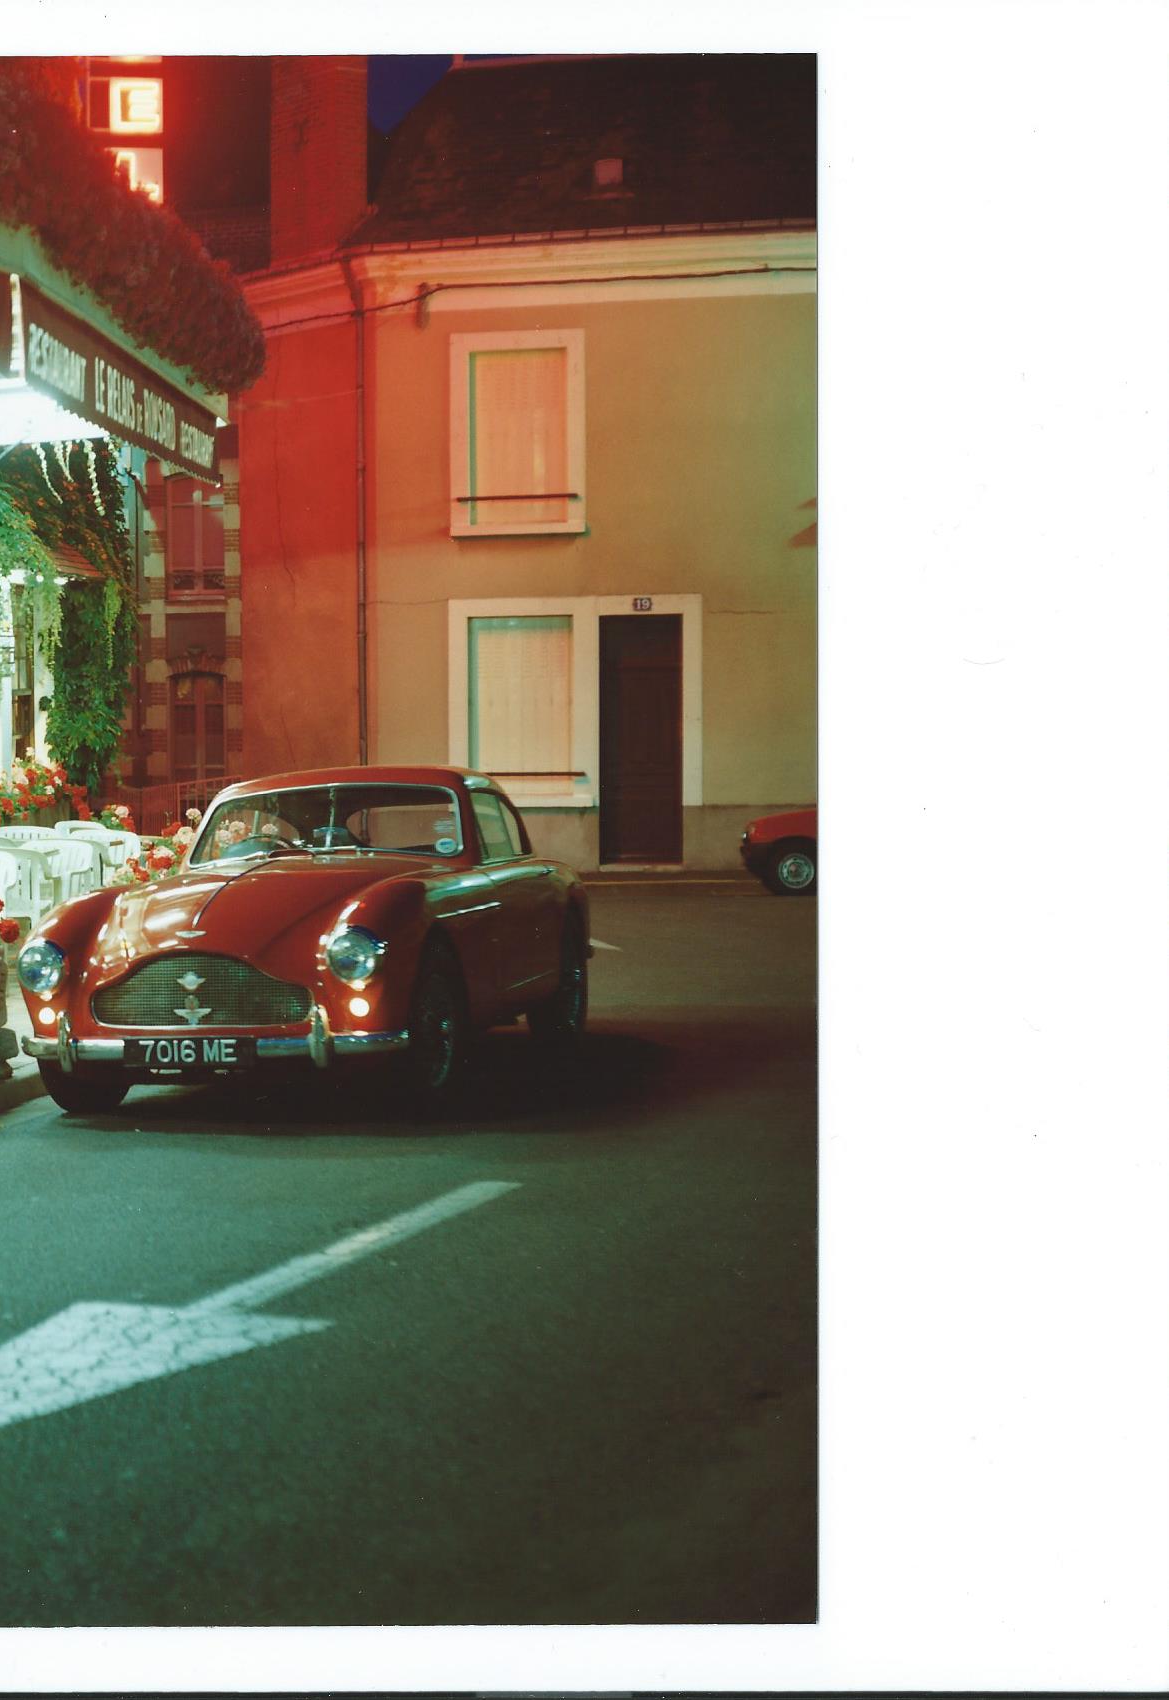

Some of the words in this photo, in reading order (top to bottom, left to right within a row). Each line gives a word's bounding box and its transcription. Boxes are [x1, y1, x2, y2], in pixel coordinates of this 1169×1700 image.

[94, 356, 106, 414] LE
[635, 598, 651, 610] 19
[138, 1038, 197, 1063] 7016
[202, 1038, 238, 1063] ME
